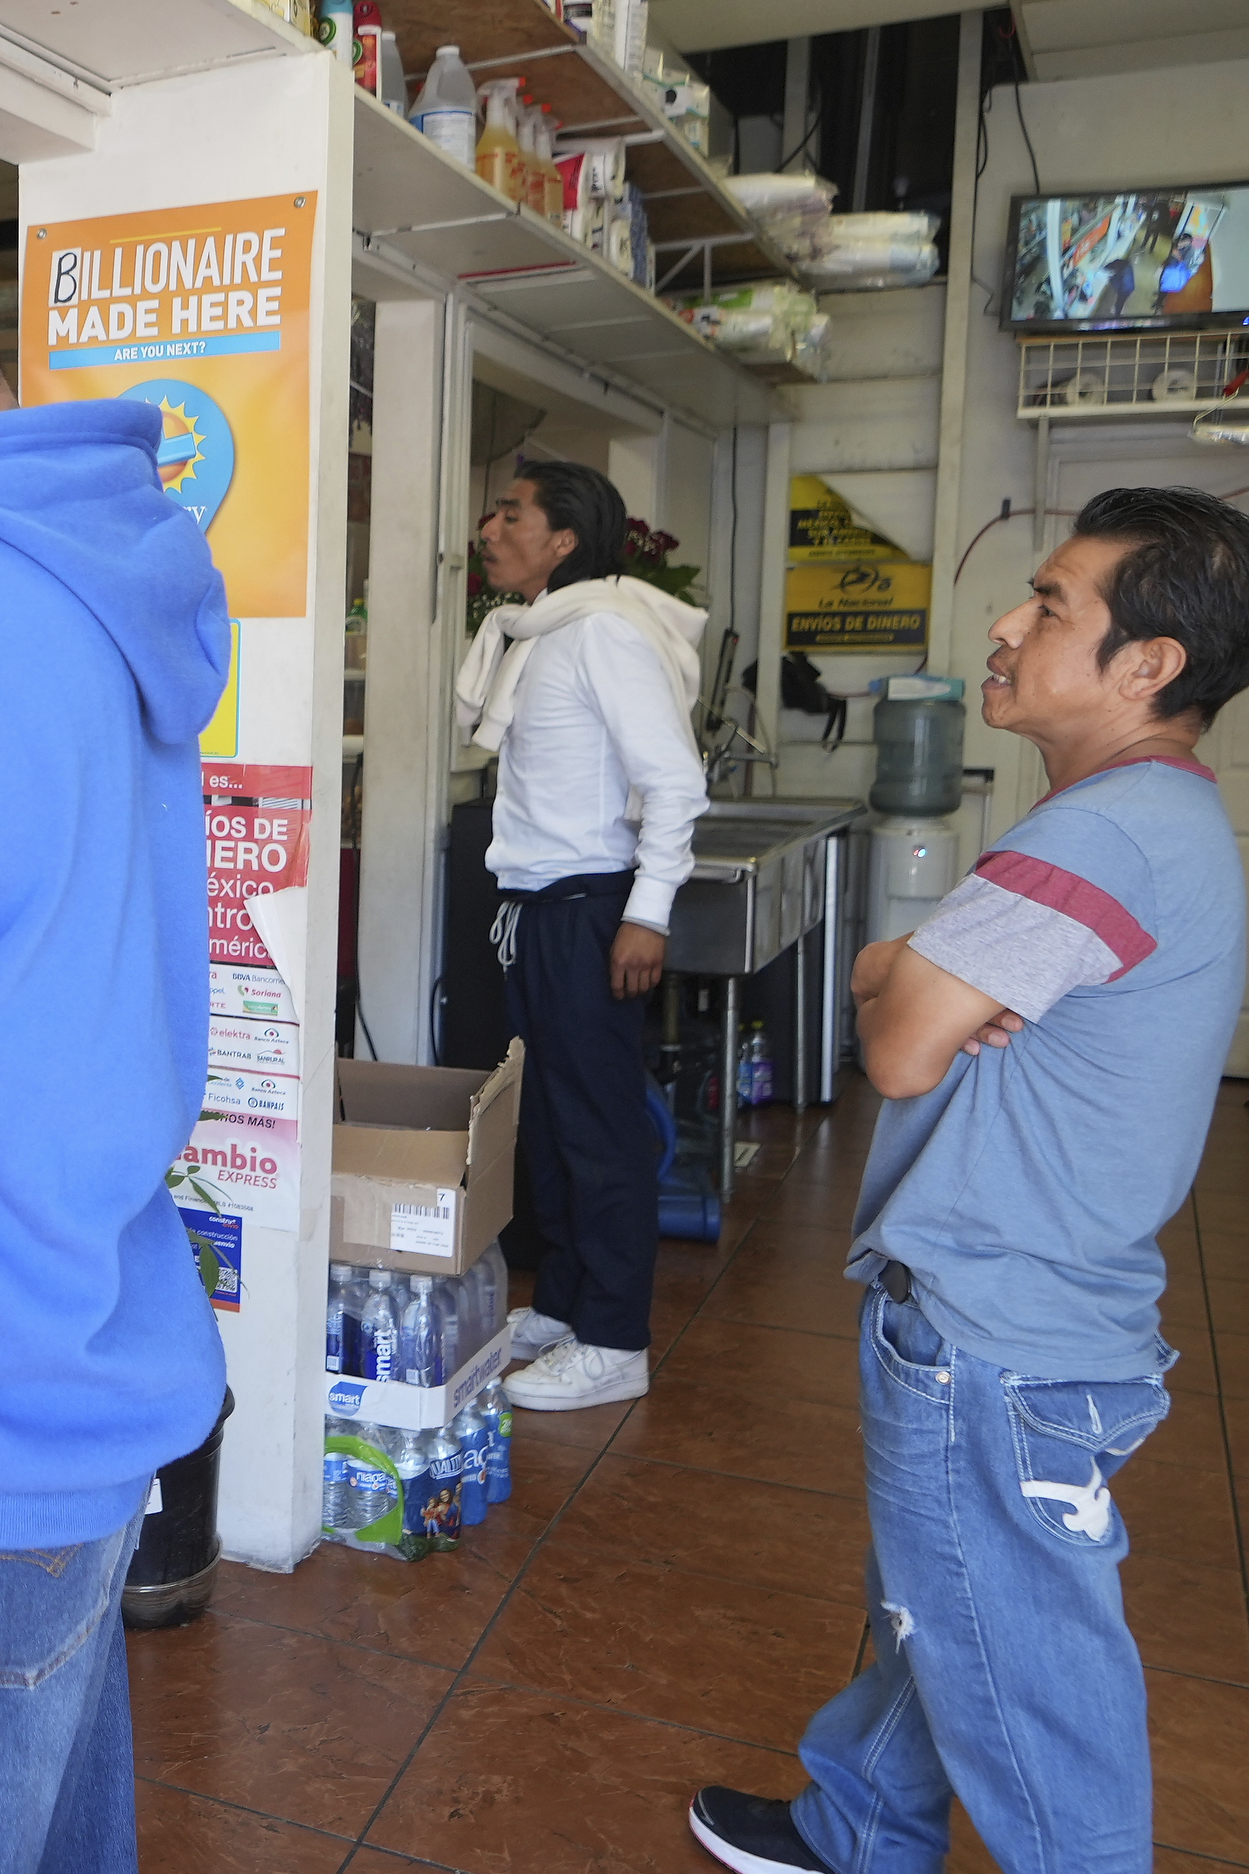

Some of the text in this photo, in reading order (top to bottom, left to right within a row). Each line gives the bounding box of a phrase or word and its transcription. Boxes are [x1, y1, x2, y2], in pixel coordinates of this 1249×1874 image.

[53, 226, 285, 304] BILLIONAIRE
[48, 286, 282, 346] MADE HERE
[114, 341, 206, 361] ARE YOU NEXT?
[845, 616, 864, 630] DE
[867, 614, 921, 630] DINERO
[254, 818, 288, 841] DE
[251, 989, 281, 998] Soriana
[219, 1028, 251, 1040] elektra
[217, 1049, 252, 1060] BANTRAB
[208, 1092, 241, 1105] Ficohsa
[247, 1116, 276, 1129] MÁS!
[176, 1143, 277, 1175] ambio
[217, 1169, 278, 1190] EXPRESS
[438, 1193, 445, 1202] 7
[453, 1347, 502, 1409] smartwater
[328, 1391, 361, 1405] smart
